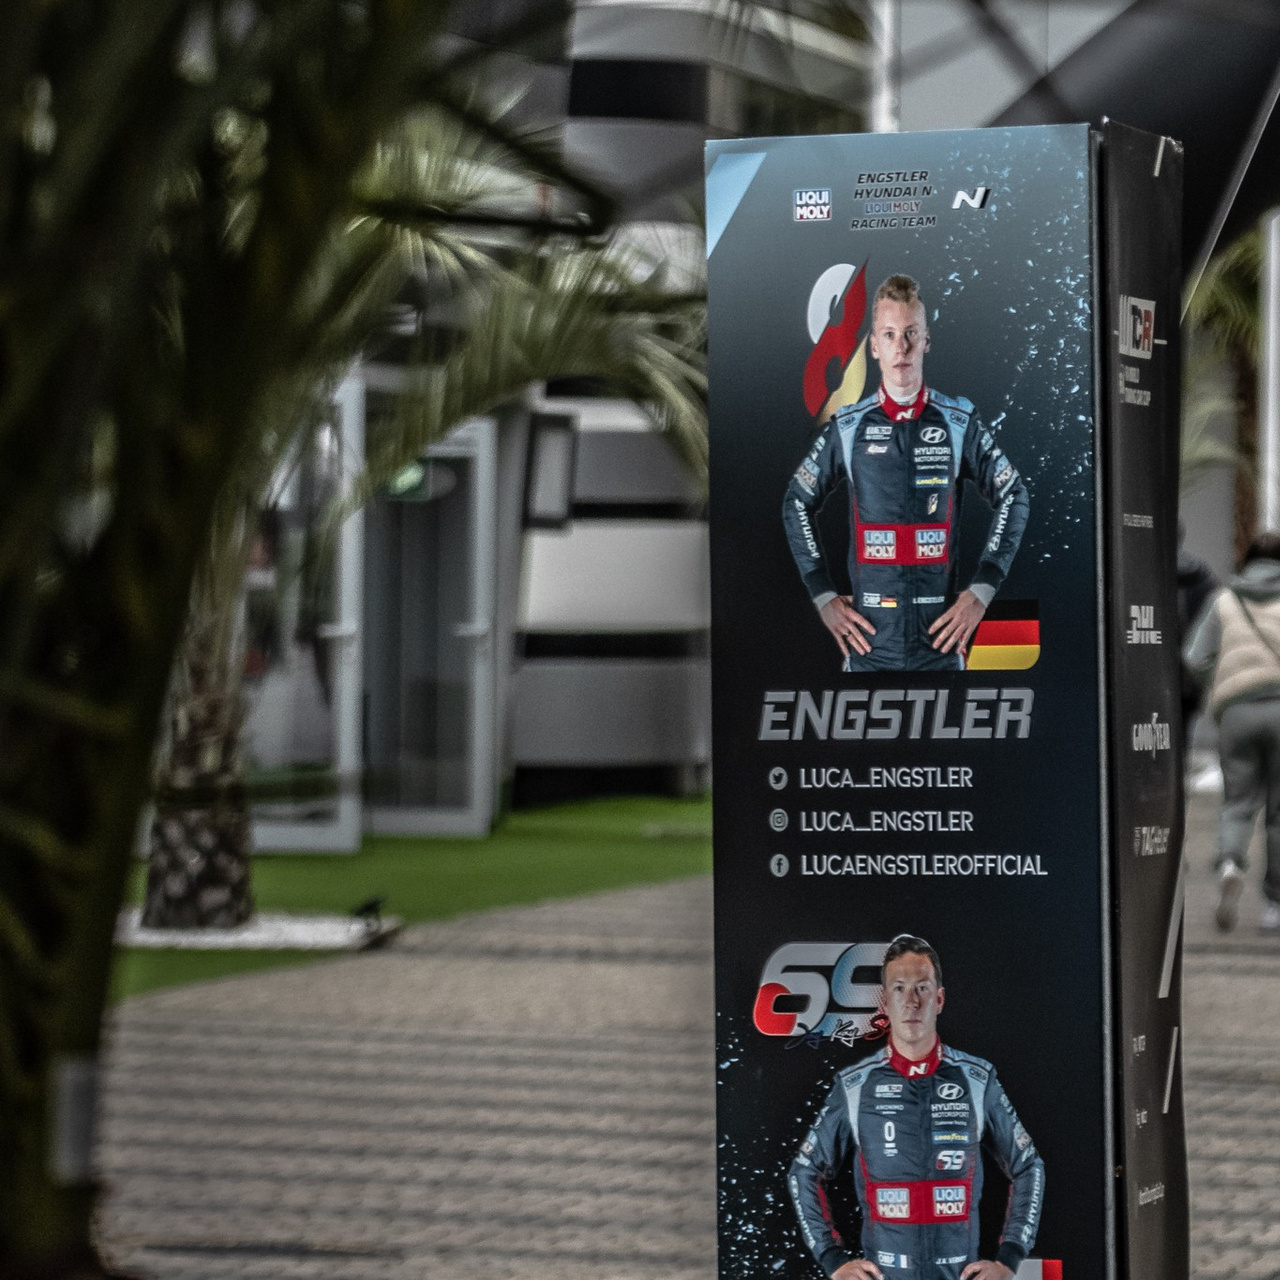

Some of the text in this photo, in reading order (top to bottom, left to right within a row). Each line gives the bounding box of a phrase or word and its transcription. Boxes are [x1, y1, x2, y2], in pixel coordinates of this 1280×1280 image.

[857, 171, 929, 184] ENGSTLER
[796, 191, 829, 205] LIQUI
[854, 185, 933, 199] HYUNDAI N
[796, 206, 831, 220] MOLY
[851, 216, 937, 230] RACING TEAM
[865, 545, 895, 557] MOLY
[918, 544, 946, 557] MOLY
[758, 687, 1035, 741] ENGSTLER
[800, 767, 973, 788] LUCA_ENGSTLER
[800, 811, 974, 832] LUCA_ENGSTLER
[801, 855, 1048, 876] LUCAENGSTLEROFFICIAL
[753, 941, 888, 1037] 69
[878, 1204, 909, 1217] MOLY
[937, 1202, 965, 1215] MOLY
